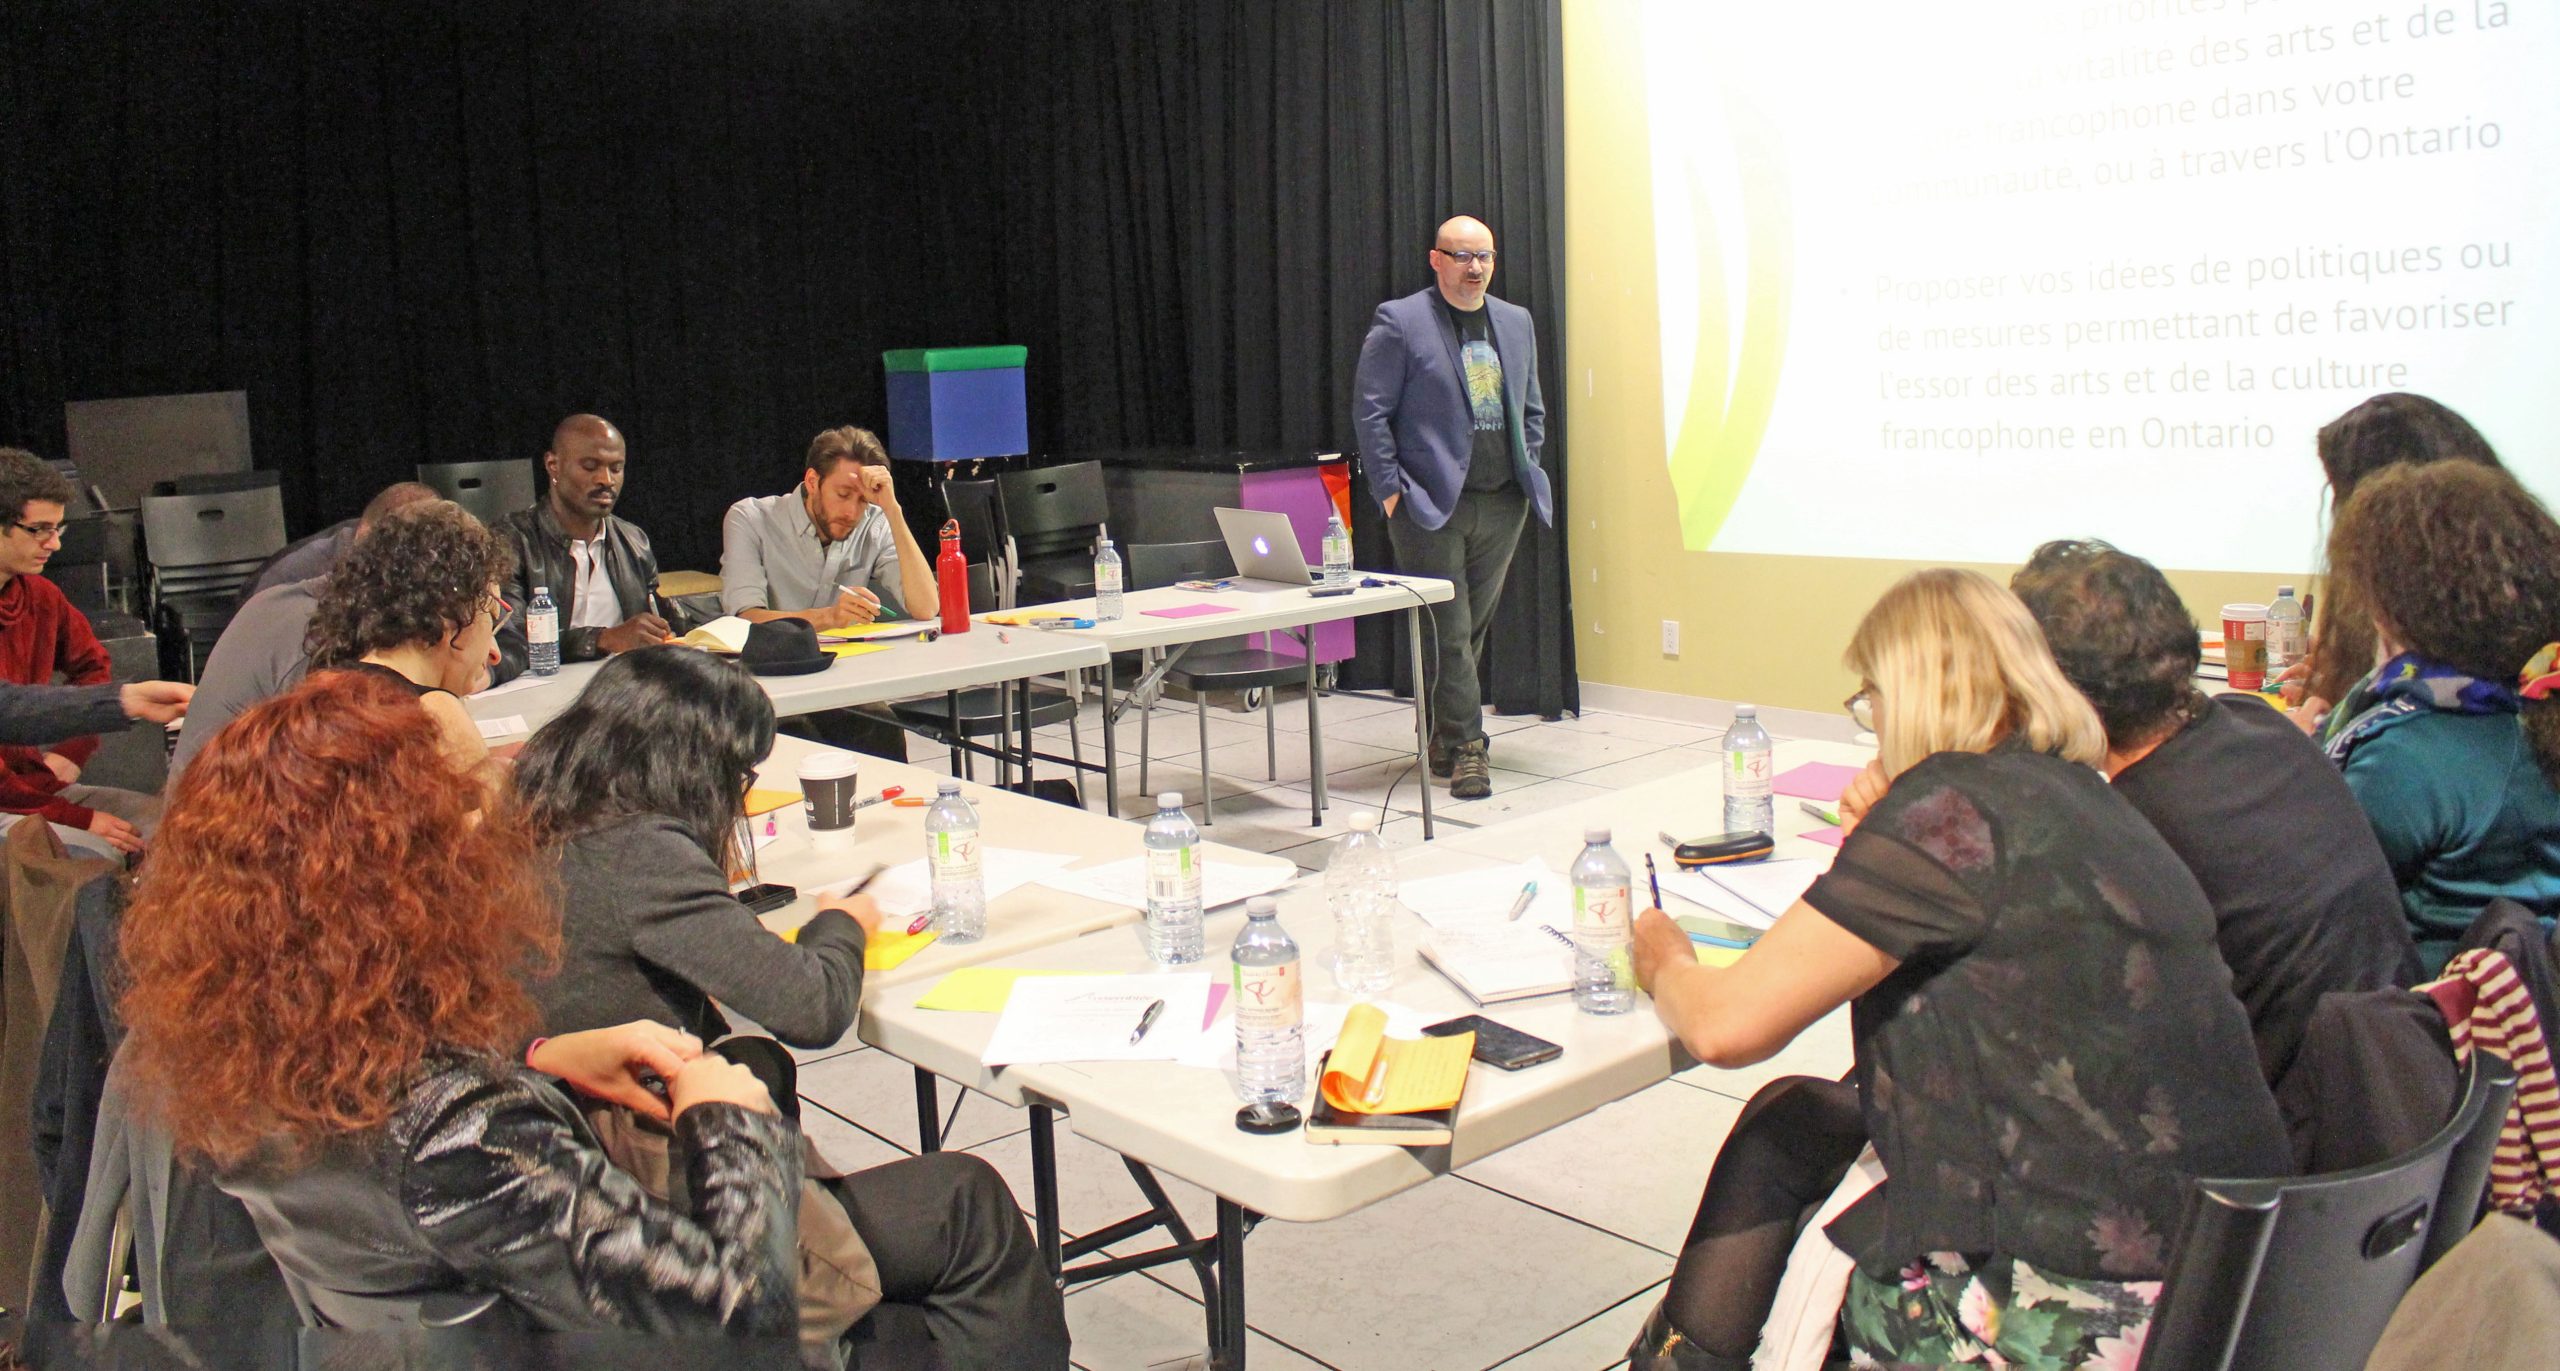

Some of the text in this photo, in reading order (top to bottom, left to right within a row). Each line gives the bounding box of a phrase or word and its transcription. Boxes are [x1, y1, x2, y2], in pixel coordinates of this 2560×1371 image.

[2189, 34, 2250, 68] des
[2265, 23, 2335, 58] arts
[2352, 14, 2390, 46] et
[2406, 2, 2456, 39] de
[2474, 0, 2511, 31] la
[2211, 86, 2298, 120] dans
[2312, 71, 2415, 108] votre
[2095, 160, 2134, 186] ou
[2149, 147, 2165, 181] à
[2180, 140, 2305, 177] travers
[2324, 114, 2503, 164] l'Ontario
[1876, 241, 2512, 306] Proposer vos idées de politiques ou
[1877, 294, 2515, 351] de mesures permettant de favoriser
[1984, 367, 2037, 398] des
[2050, 368, 2110, 396] arts
[2124, 366, 2156, 394] et
[2170, 360, 2210, 392] de
[2226, 360, 2255, 391] la
[2271, 357, 2408, 390] culture
[1881, 416, 2274, 457] francophone en Ontario
